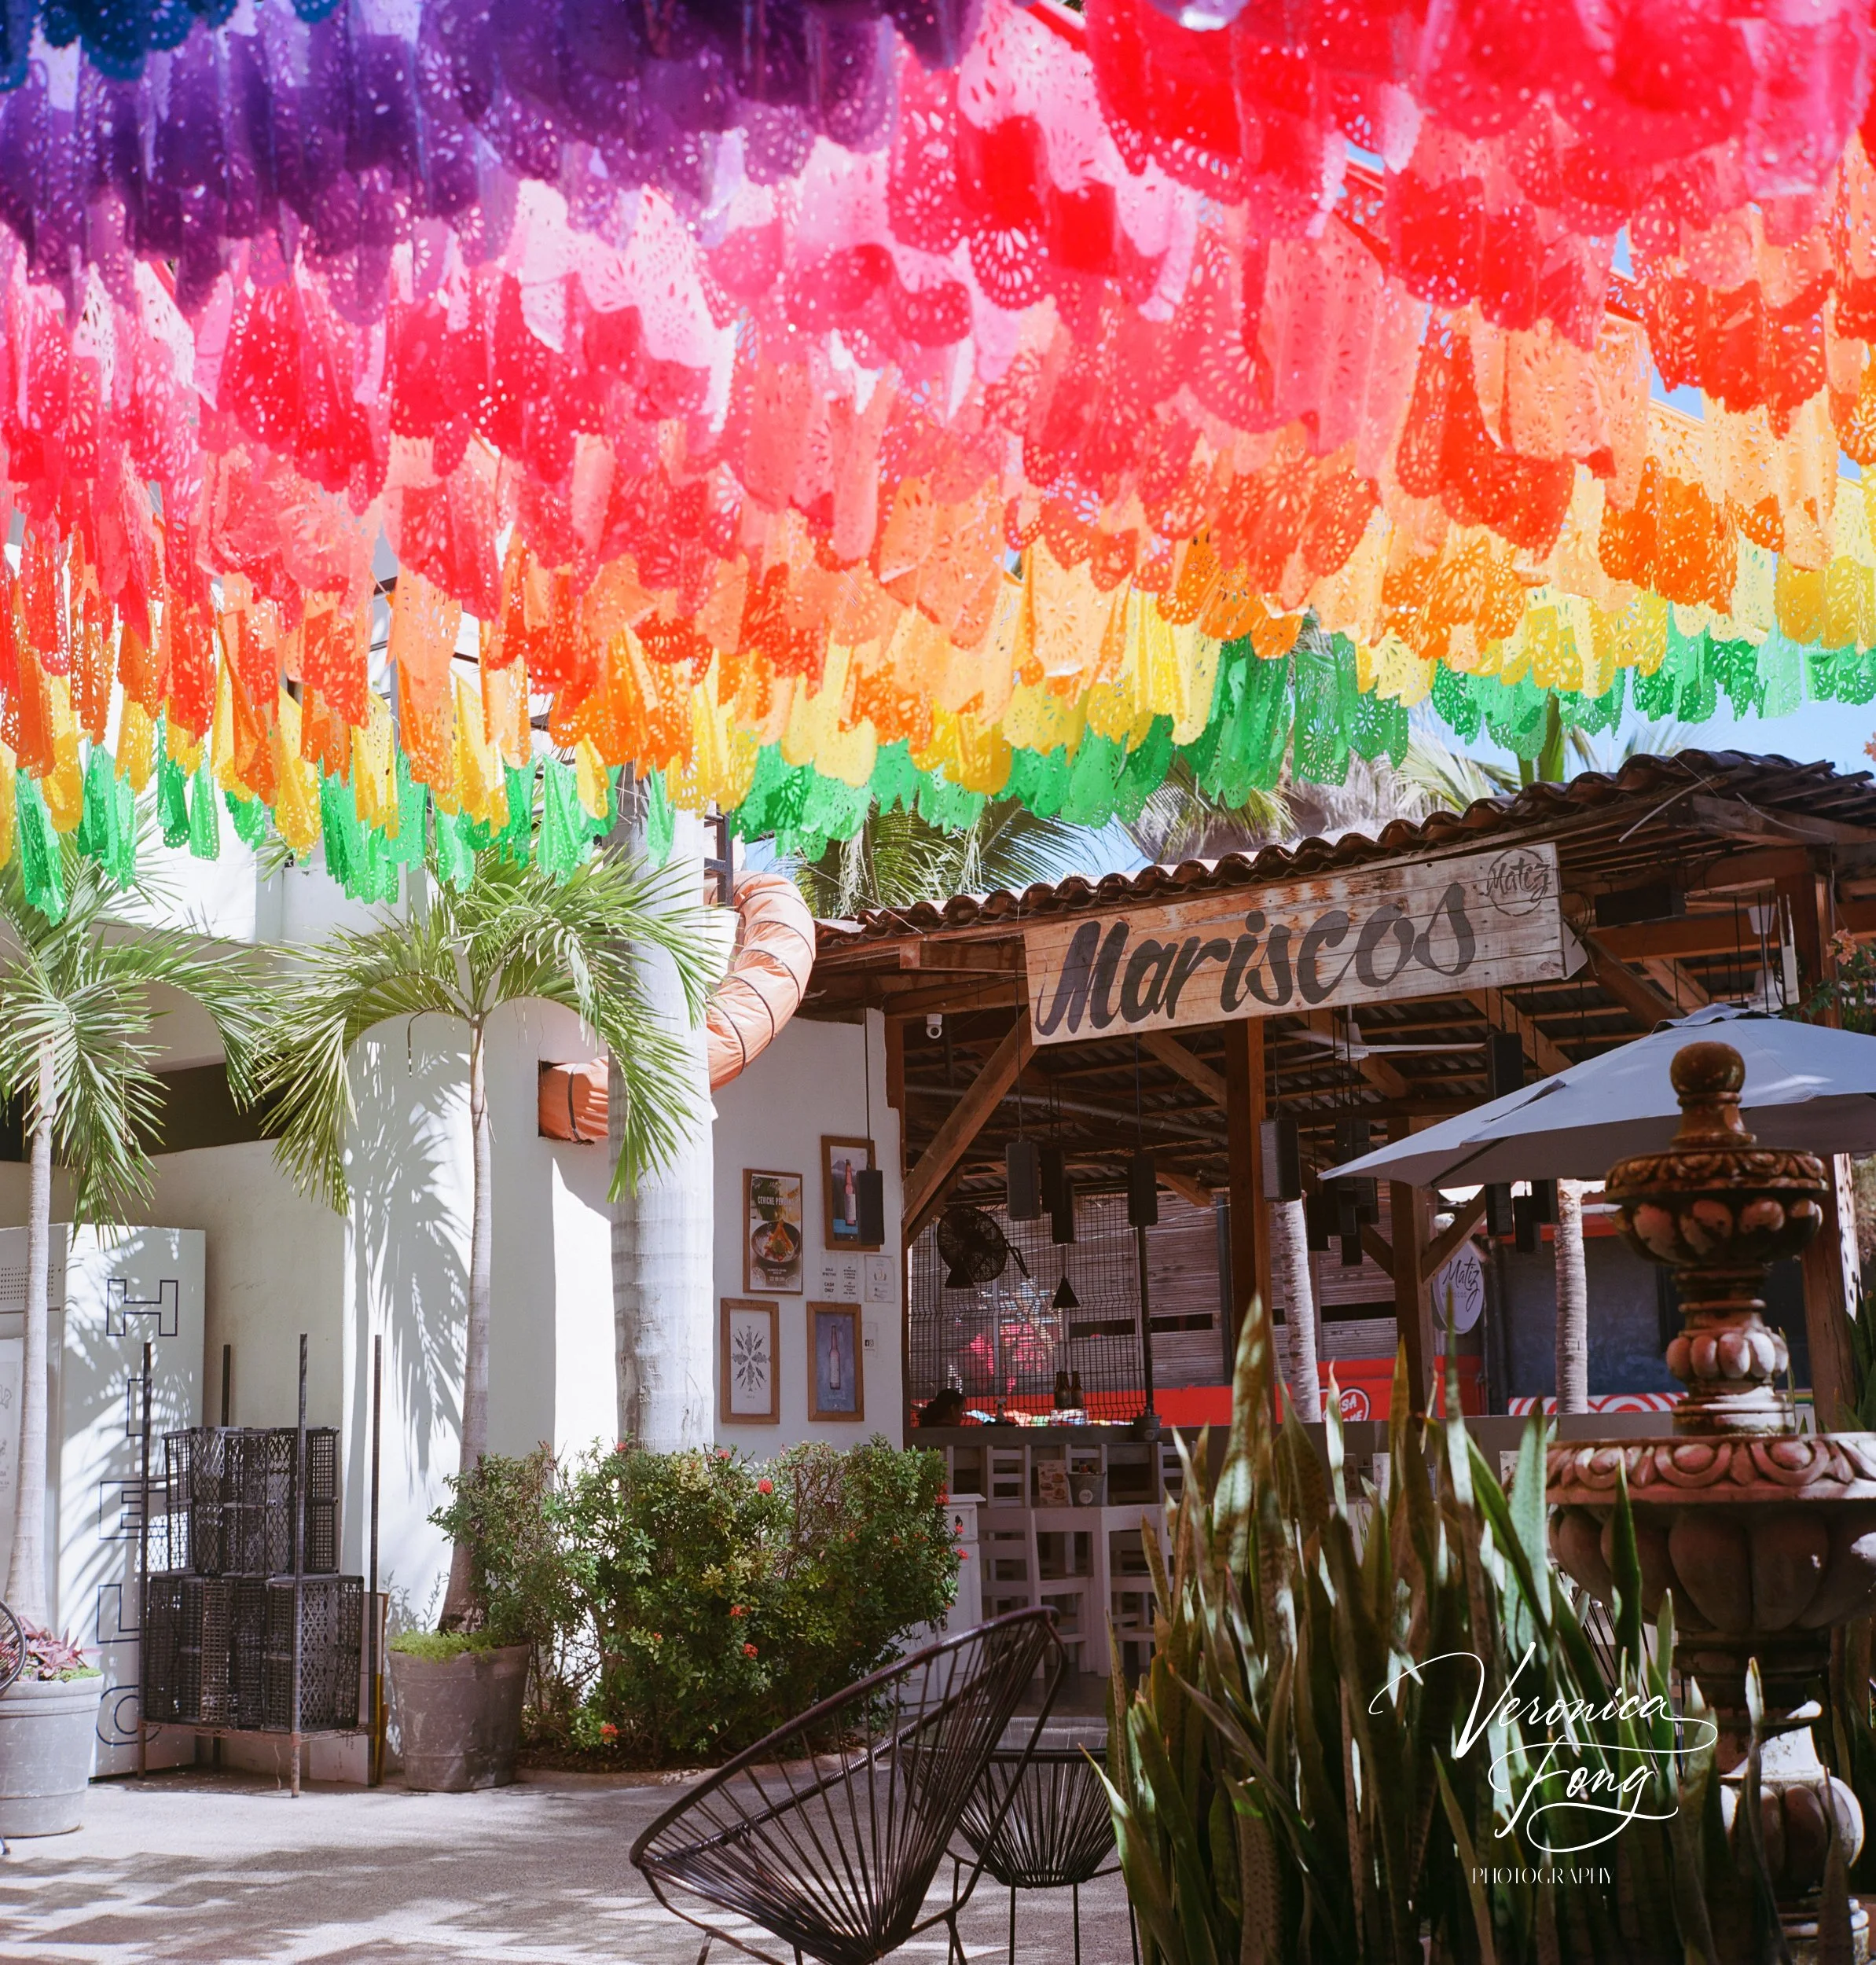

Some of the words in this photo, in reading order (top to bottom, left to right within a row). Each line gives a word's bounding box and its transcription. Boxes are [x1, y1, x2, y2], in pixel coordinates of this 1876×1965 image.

[1484, 857, 1551, 903] Matiz
[1035, 881, 1475, 1036] Mariscos
[1442, 1256, 1480, 1312] Matiz
